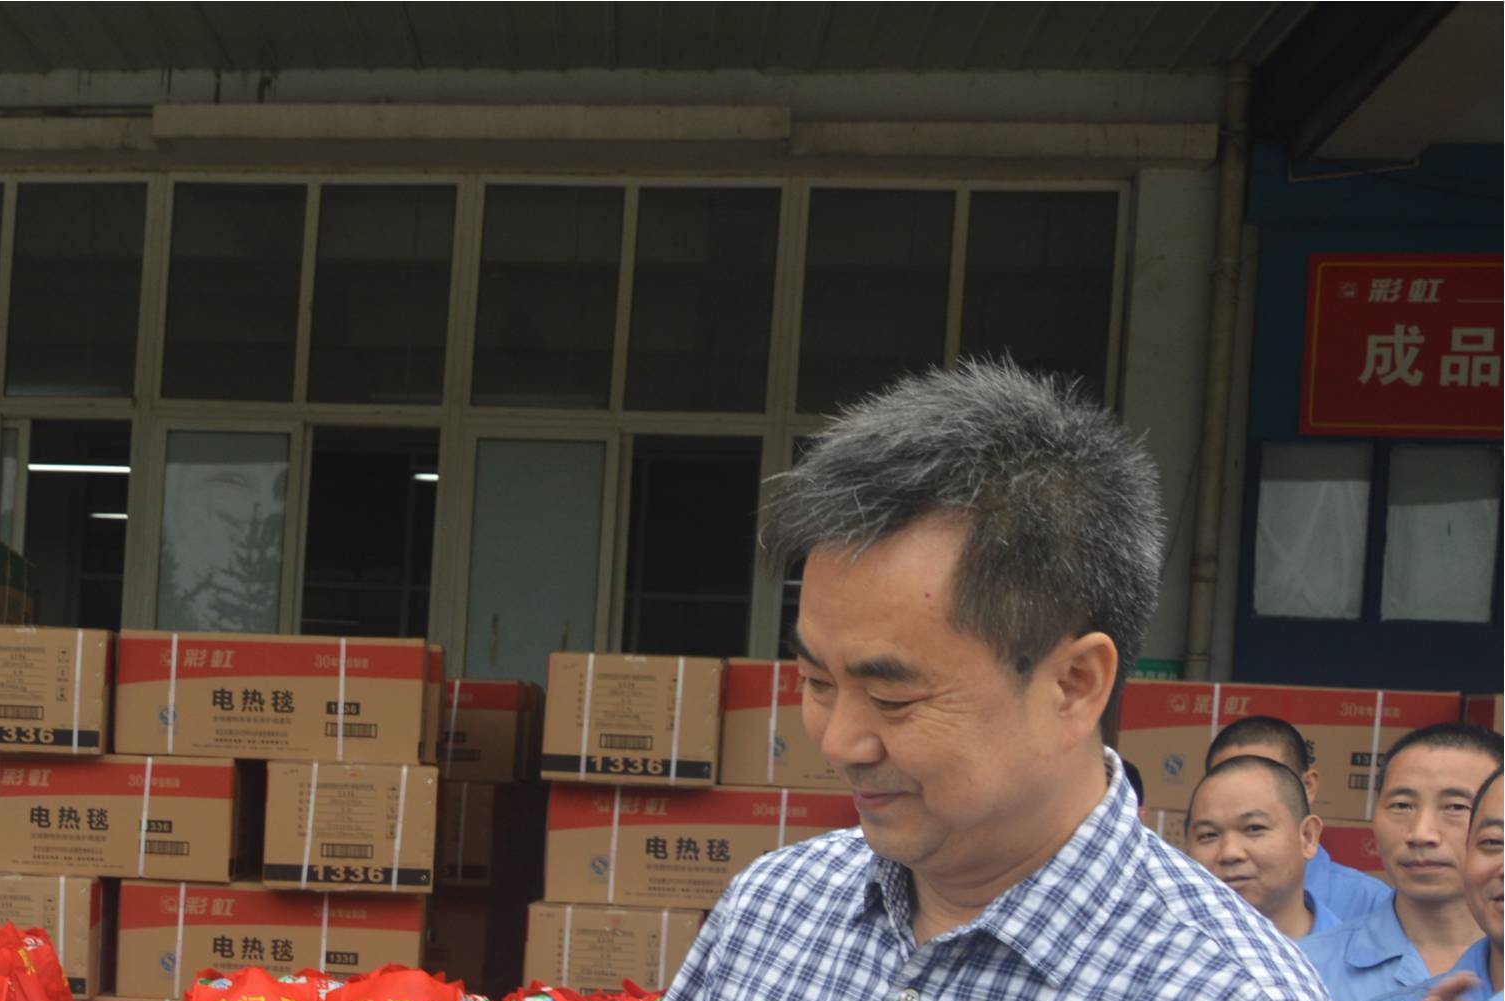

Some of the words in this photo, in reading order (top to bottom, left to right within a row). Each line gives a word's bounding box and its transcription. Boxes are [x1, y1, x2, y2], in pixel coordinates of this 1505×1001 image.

[1368, 278, 1444, 304] 彩虹
[1359, 324, 1501, 387] 成品
[212, 688, 296, 714] 电热毯
[591, 757, 664, 775] 1336
[30, 805, 110, 832] 电热毯
[645, 836, 731, 863] 电热毯
[313, 865, 384, 883] 1336
[212, 936, 295, 963] 电热毯
